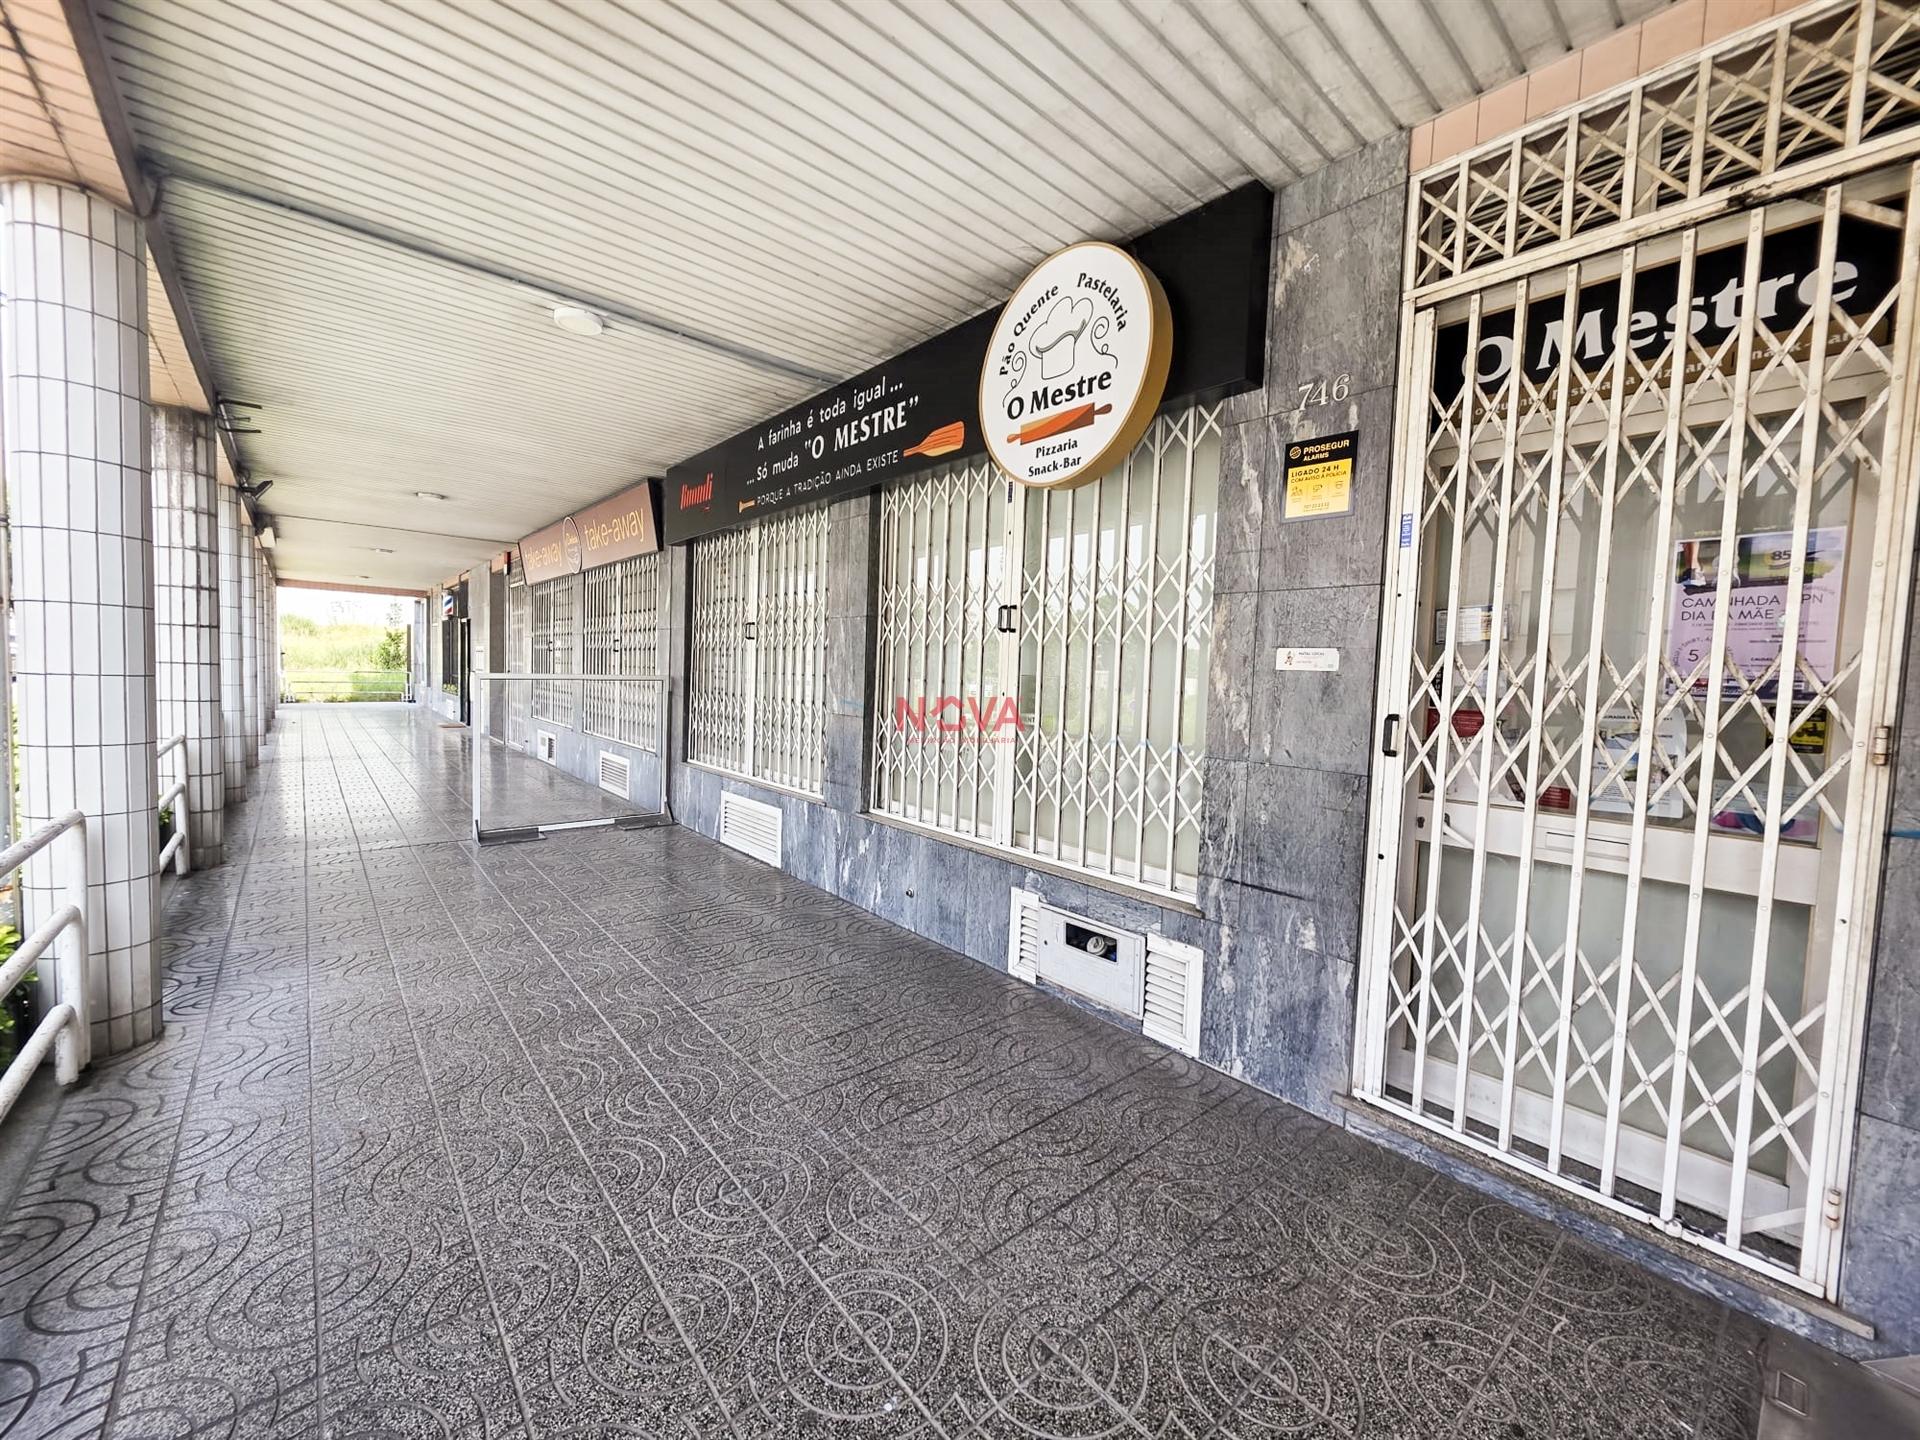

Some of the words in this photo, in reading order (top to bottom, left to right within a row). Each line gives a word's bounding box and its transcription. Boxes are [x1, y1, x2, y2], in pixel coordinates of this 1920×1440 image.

[1077, 272, 1128, 332] Pastelaria
[1000, 342, 1015, 376] Pão
[1014, 285, 1059, 337] Quente
[1461, 335, 1514, 385] O
[1534, 260, 1859, 371] Mestre
[1006, 396, 1025, 420] O
[1029, 370, 1112, 414] Mestre
[1298, 373, 1350, 412] 746
[757, 436, 764, 451] A
[768, 419, 801, 446] farinha
[807, 410, 814, 429] é
[819, 398, 846, 424] toda
[852, 375, 886, 410] igual
[1035, 439, 1079, 458] Pizzaria
[1303, 439, 1350, 455] PROSEGUR
[1303, 451, 1330, 462] ALARMS
[757, 488, 783, 507] PORQUE
[786, 487, 791, 497] A
[793, 471, 832, 495] TRADIÇÃO
[835, 463, 862, 481] AINDA
[867, 450, 899, 472] EXISTE
[772, 452, 799, 476] muda
[1028, 455, 1082, 477] Snack-Bar
[1291, 467, 1320, 478] LIGADO
[1322, 465, 1331, 473] 24
[584, 508, 645, 552] take-away
[524, 540, 563, 571] take-away
[1682, 611, 1706, 621] DIA
[1738, 607, 1774, 620] MÃE
[1688, 649, 1700, 662] 5
